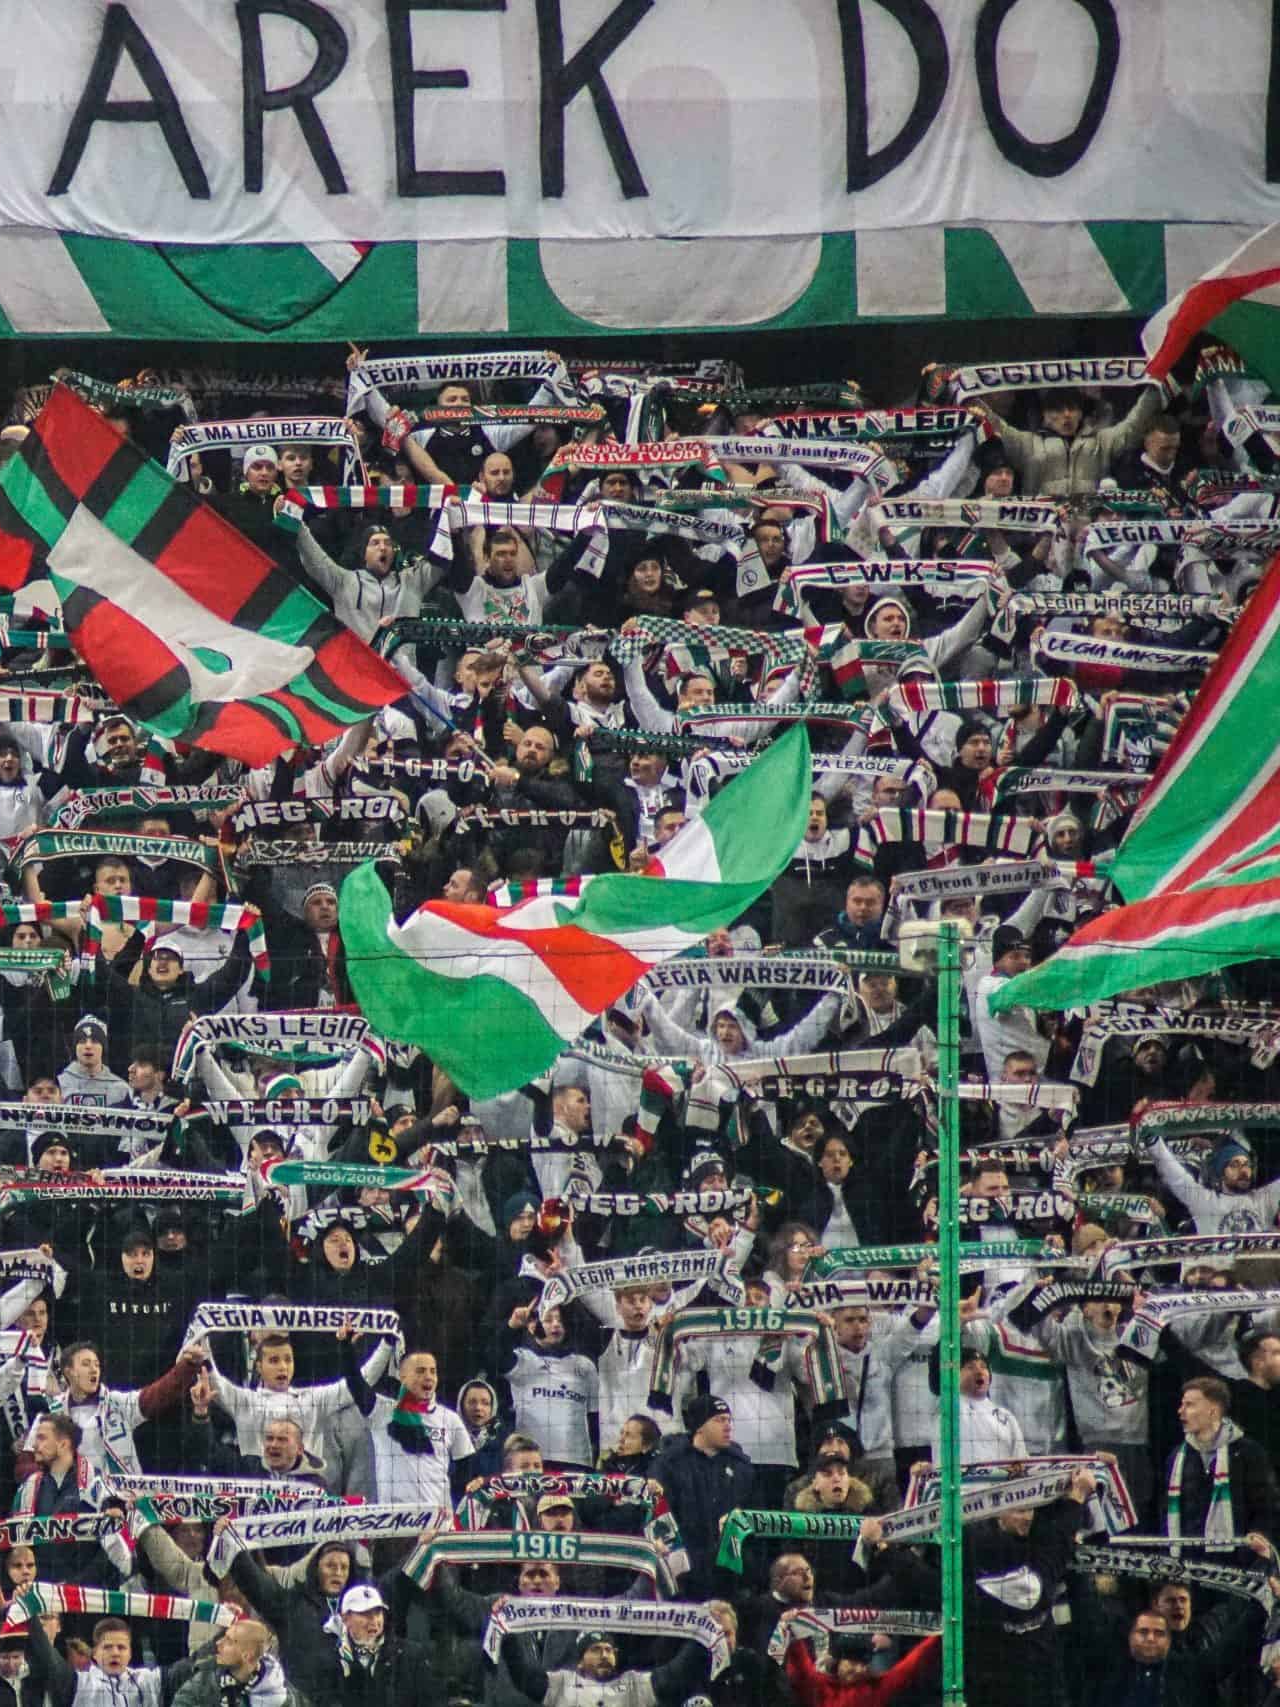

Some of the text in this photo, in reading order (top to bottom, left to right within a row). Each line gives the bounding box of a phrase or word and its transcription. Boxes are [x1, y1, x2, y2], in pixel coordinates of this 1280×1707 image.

[47, 0, 1122, 199] AREK DO
[358, 363, 419, 386] LEGIA
[427, 360, 558, 380] WARSZAWA
[205, 424, 233, 442] MA
[238, 423, 277, 439] LEGII
[281, 422, 314, 438] BEZ
[1033, 594, 1194, 612] LEGIA WARSZAWA
[836, 759, 897, 774] LEAGUE
[54, 834, 207, 866] LEGIA WARSZAWA
[644, 965, 851, 991] LEGIA WARSZAWA
[192, 1015, 368, 1042] CWKS LEGIA
[570, 1256, 717, 1288] LEGIA WARSZAWA
[200, 1311, 265, 1329] LEGIA
[722, 1309, 784, 1331] 1916
[245, 1511, 433, 1540] LEGIA WARSZAWA
[514, 1534, 576, 1560] 1916
